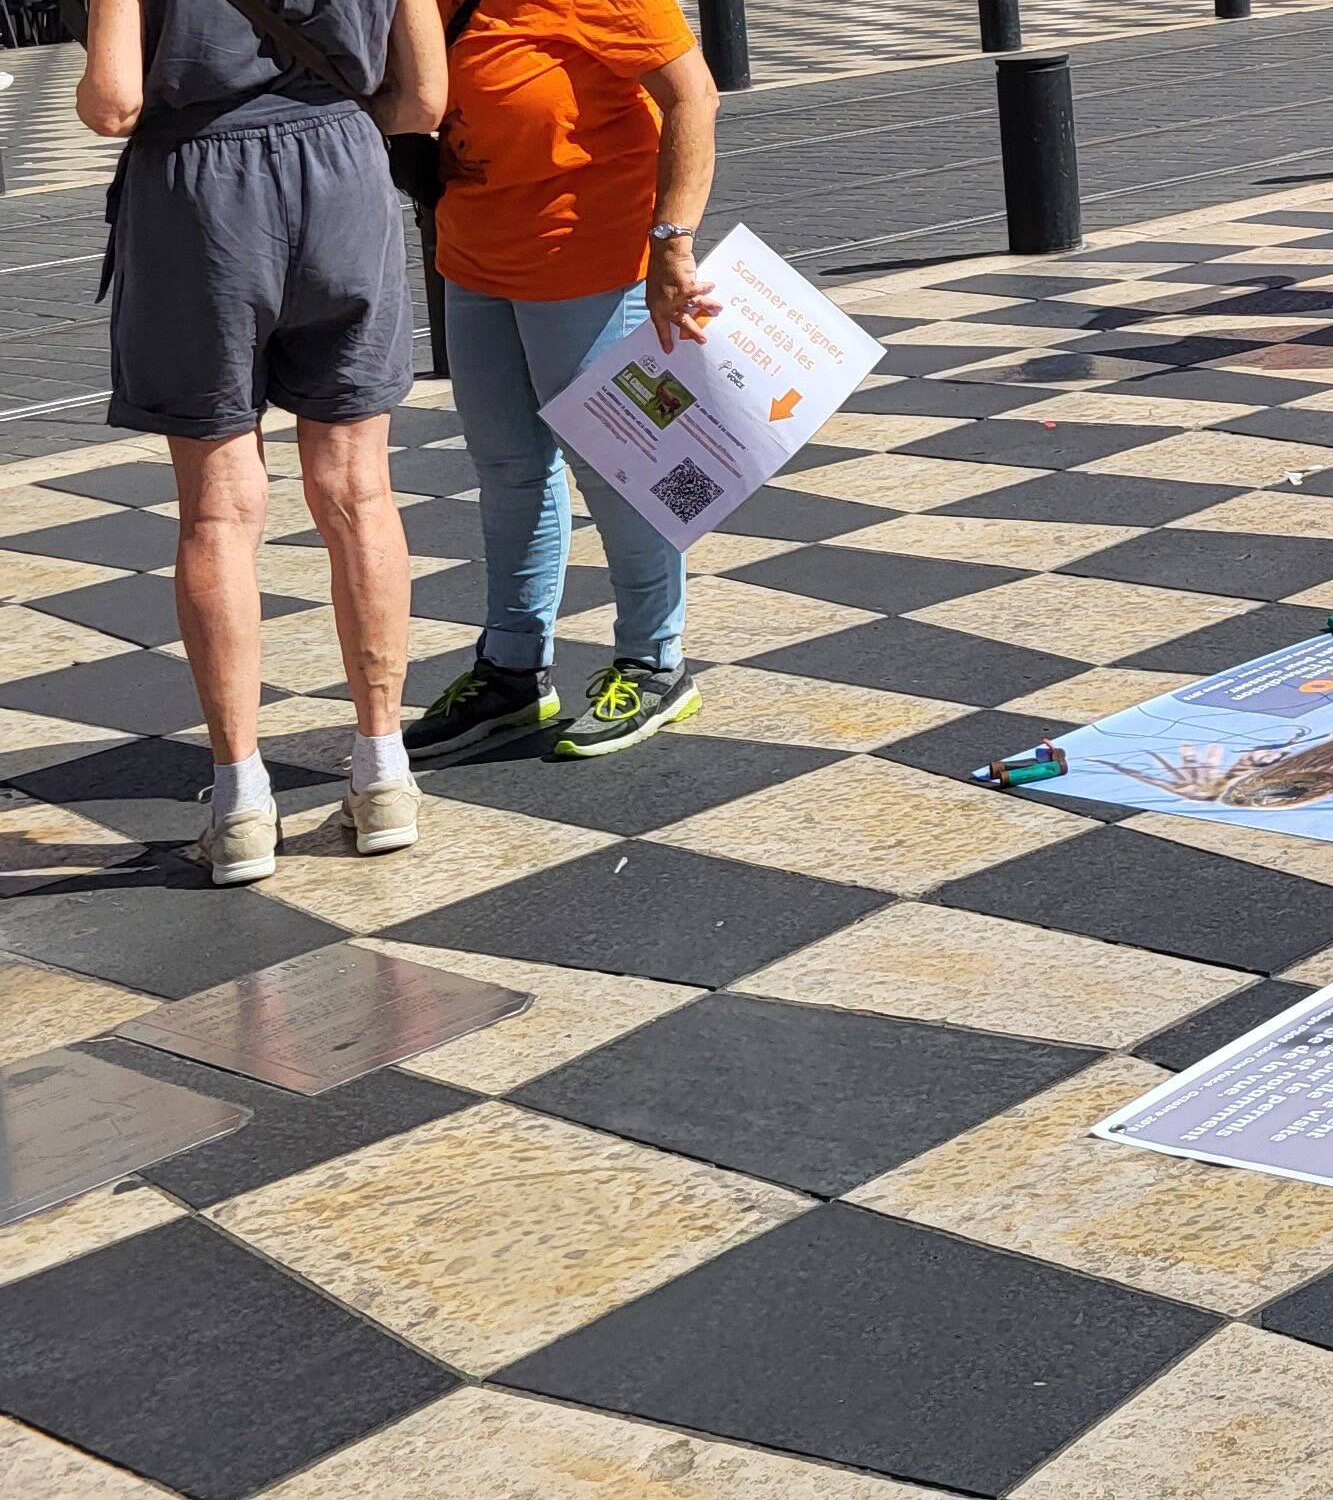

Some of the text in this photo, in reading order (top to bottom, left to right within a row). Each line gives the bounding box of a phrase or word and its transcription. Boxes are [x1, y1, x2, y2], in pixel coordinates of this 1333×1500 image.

[730, 258, 850, 366] Scanner et signer,
[728, 293, 818, 371] c'est déjà les
[726, 327, 774, 370] AIDER
[725, 372, 745, 390] VOICE
[1281, 1046, 1309, 1059] de
[1291, 1059, 1321, 1070] et
[1257, 1062, 1288, 1072] la
[1218, 1075, 1264, 1098] vue.
[1284, 1083, 1311, 1093] le
[1180, 1072, 1296, 1140] notamment
[1216, 1095, 1287, 1136] permis
[1269, 1111, 1326, 1141] visite
